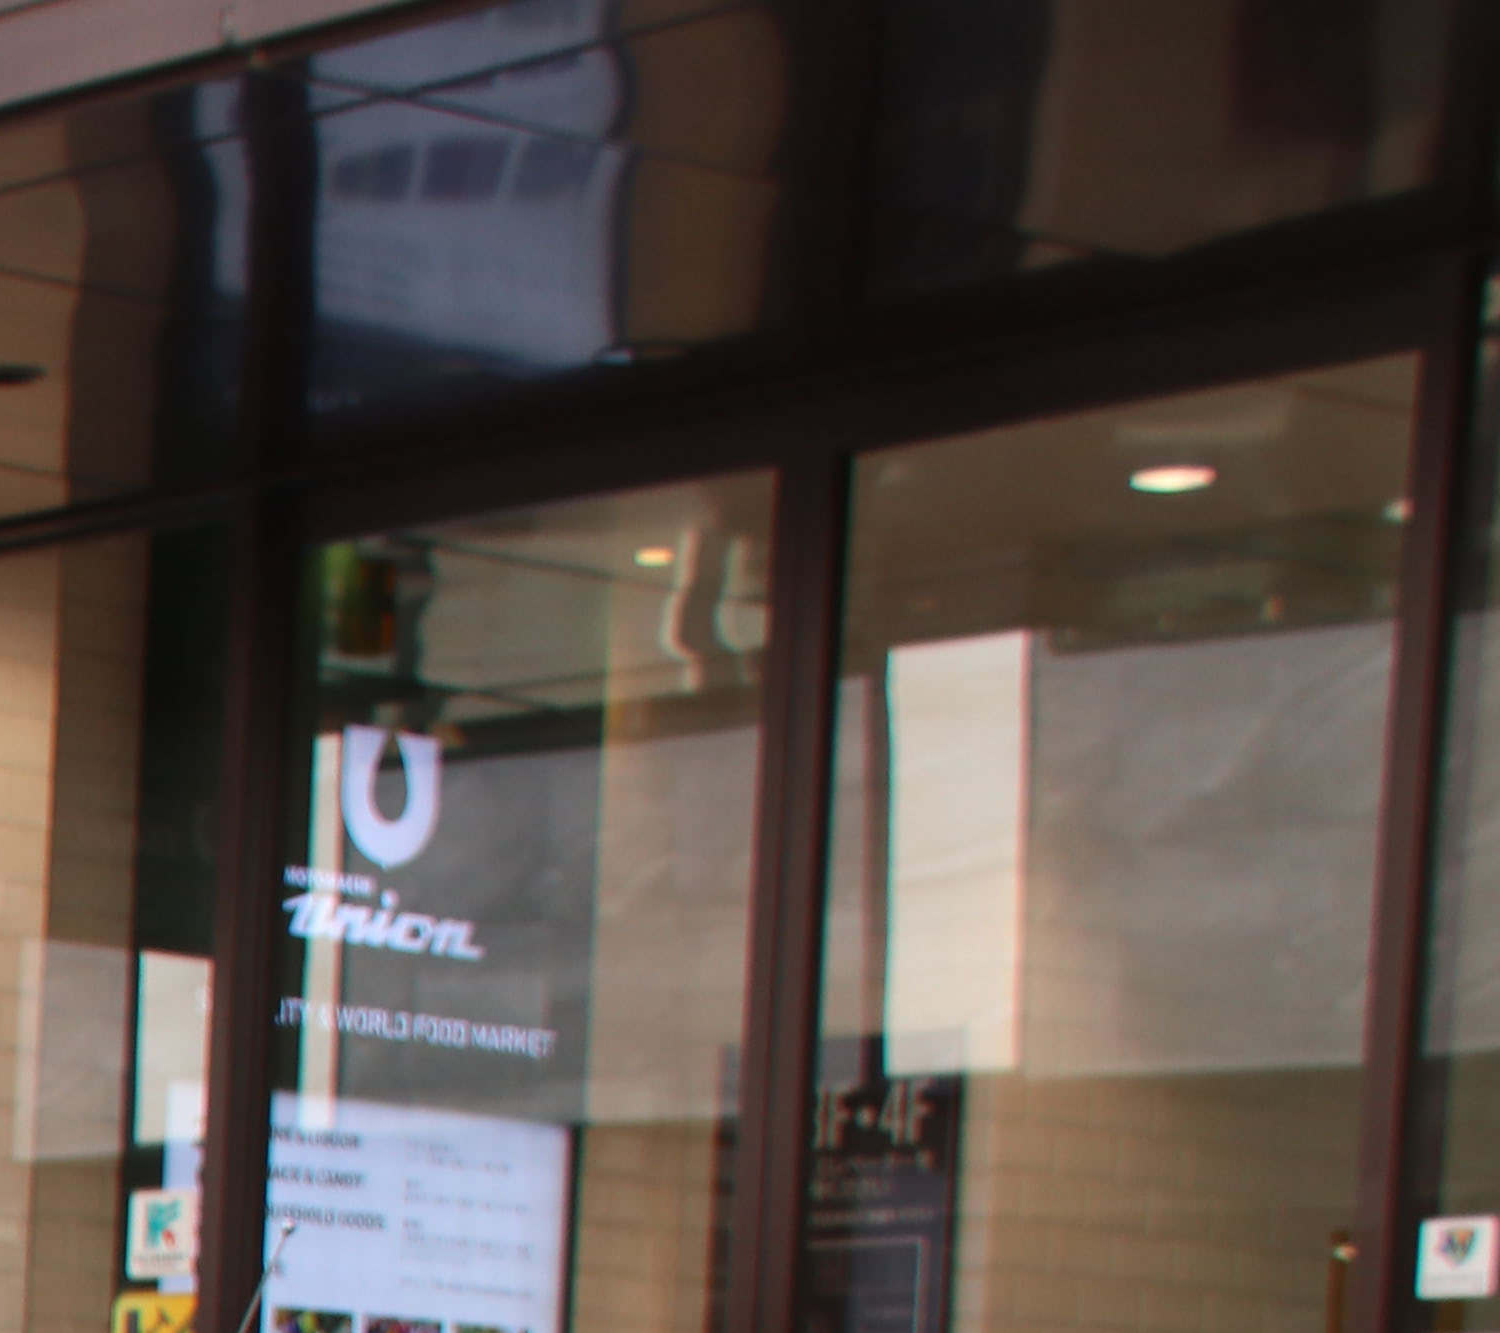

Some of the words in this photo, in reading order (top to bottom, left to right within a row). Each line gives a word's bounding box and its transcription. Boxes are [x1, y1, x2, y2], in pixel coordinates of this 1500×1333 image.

[336, 1007, 408, 1040] WORLD
[413, 1014, 467, 1047] FOOD
[471, 1021, 557, 1060] MARKET
[315, 1168, 365, 1189] CANDY
